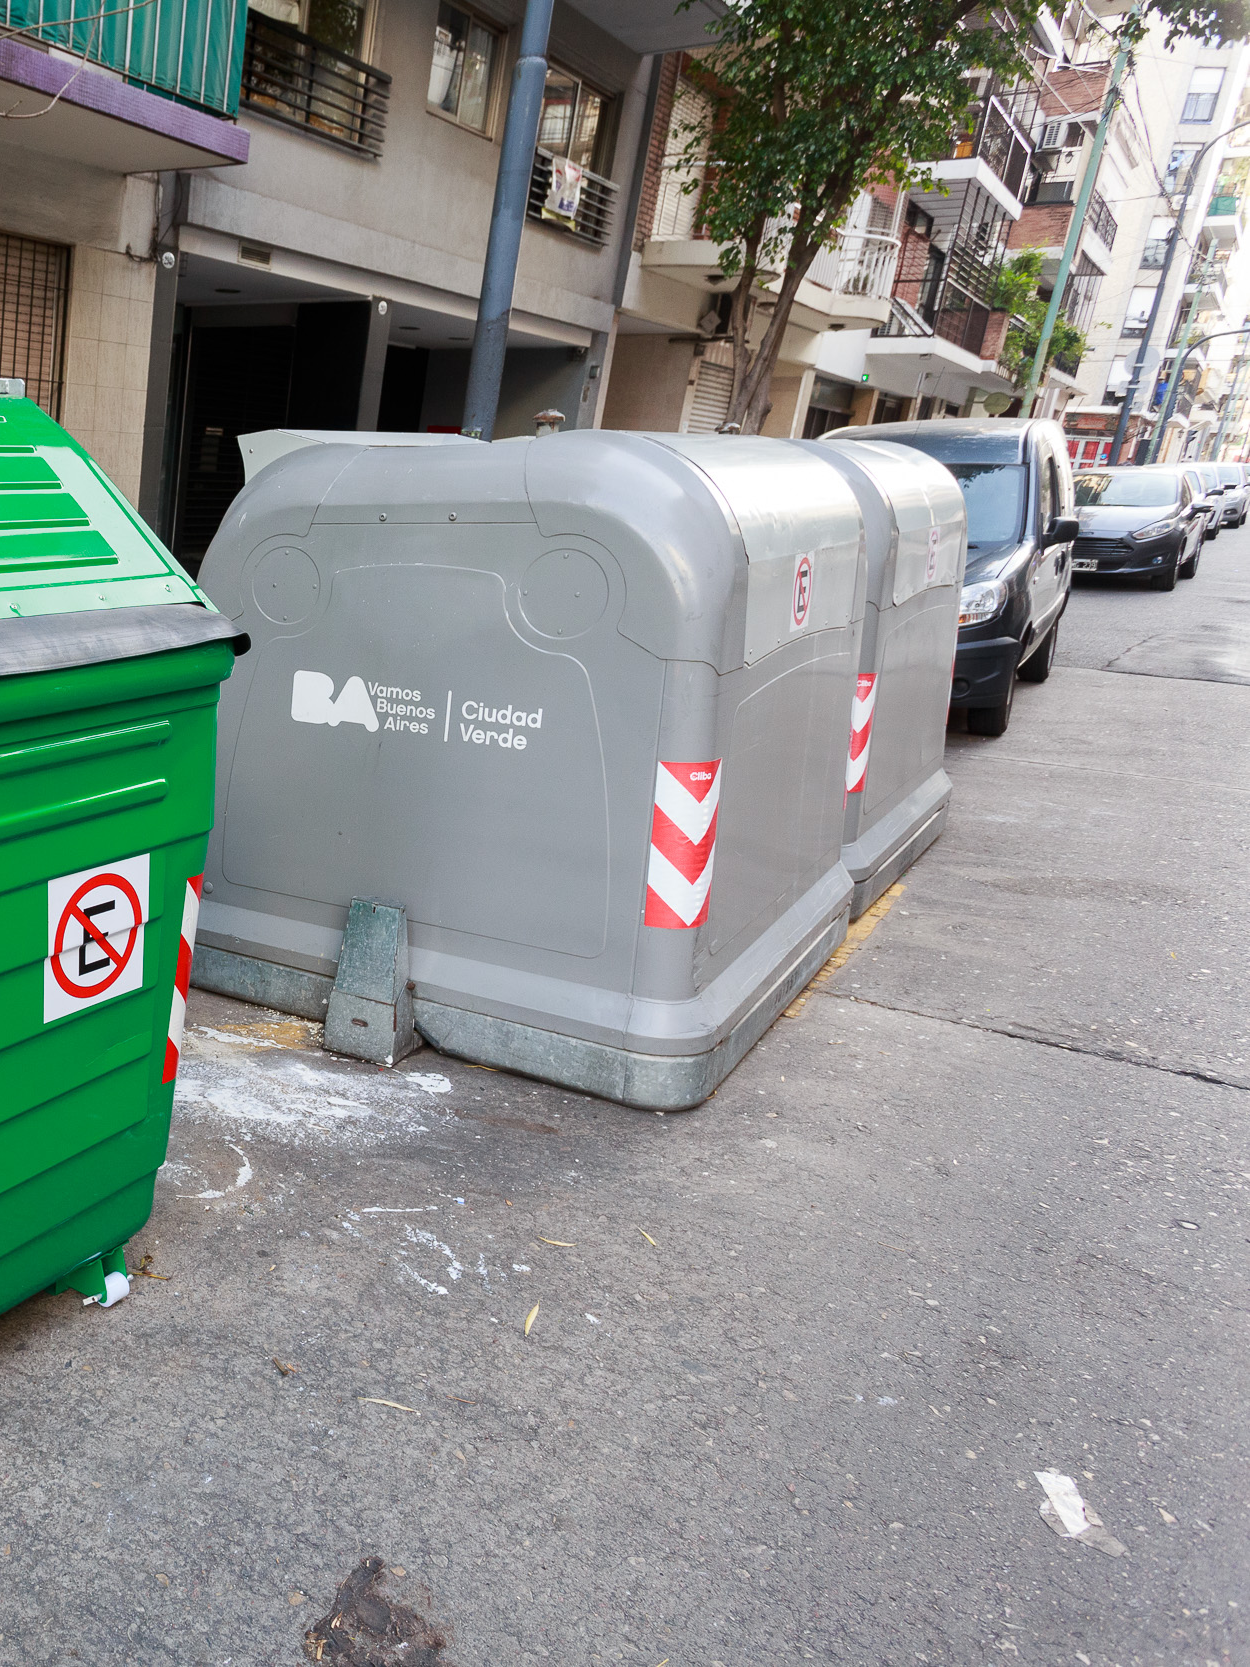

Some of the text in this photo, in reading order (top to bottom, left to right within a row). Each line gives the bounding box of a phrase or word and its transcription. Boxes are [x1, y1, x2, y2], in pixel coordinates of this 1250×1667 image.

[291, 669, 379, 732] BA
[367, 681, 421, 702] Vamos
[376, 698, 436, 720] Buenos
[461, 700, 543, 729] Ciudad
[383, 716, 429, 735] Aires
[459, 722, 528, 750] Verde
[78, 899, 116, 977] E
